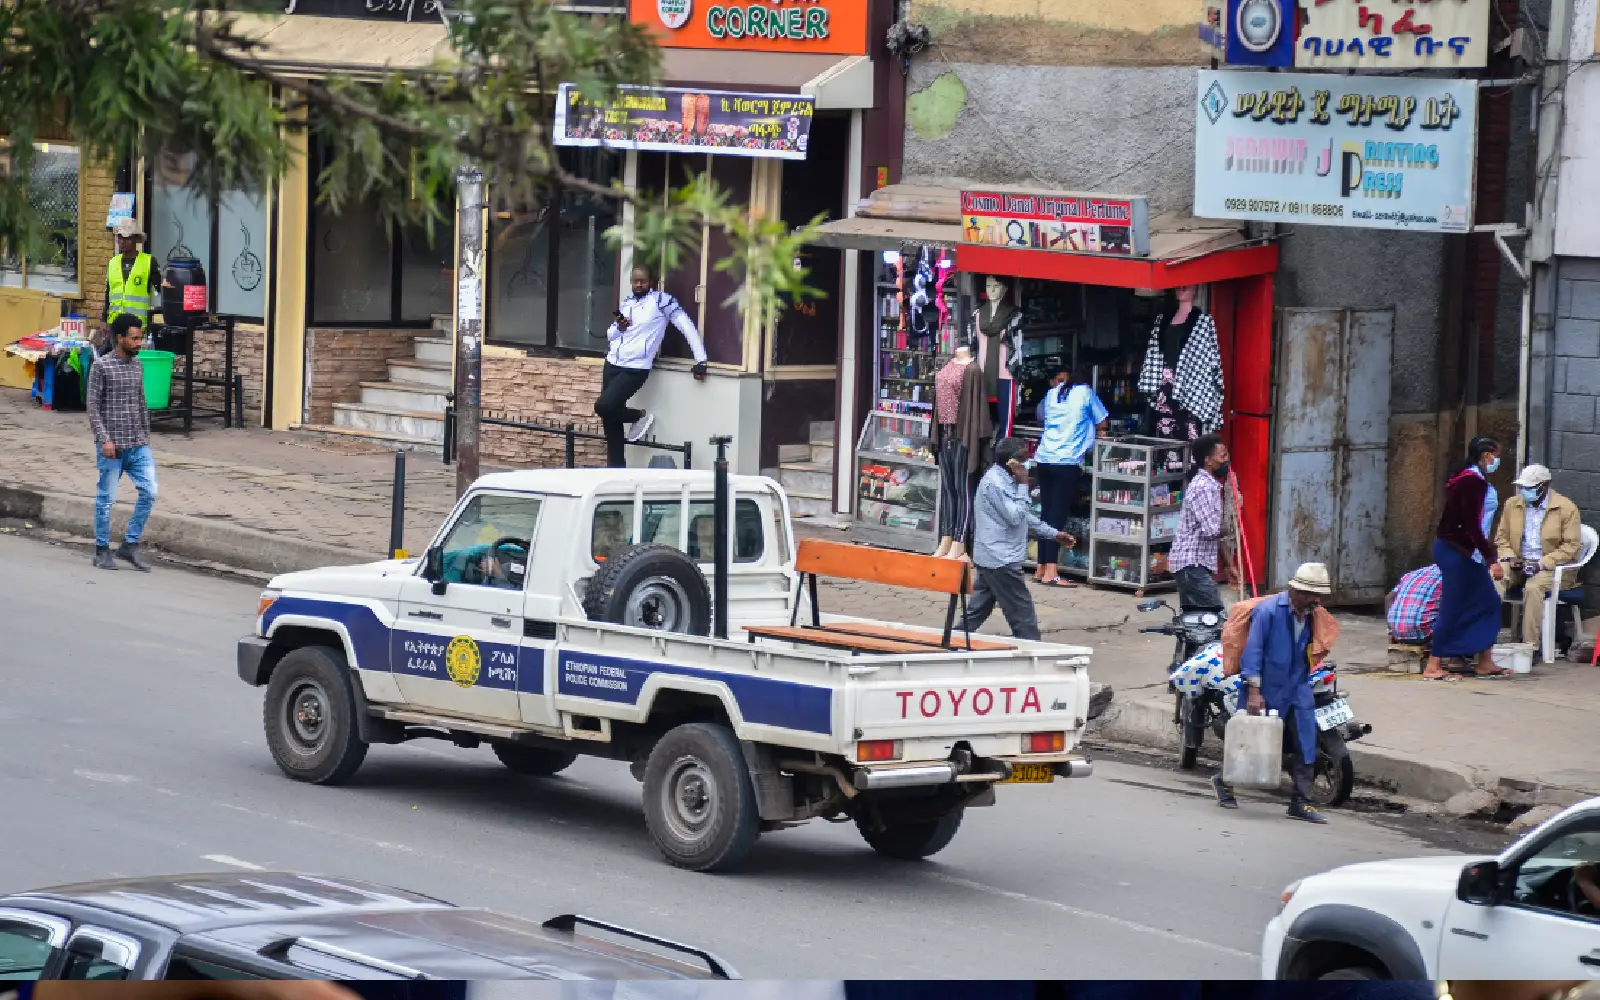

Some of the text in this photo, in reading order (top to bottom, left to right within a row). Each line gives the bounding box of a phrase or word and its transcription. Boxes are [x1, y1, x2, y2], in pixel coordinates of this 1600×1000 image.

[706, 6, 829, 39] CORNER
[1415, 36, 1471, 57] ቡና
[1420, 93, 1460, 131] ቤት
[1315, 137, 1333, 177] J
[964, 191, 999, 210] Cosmo
[1037, 196, 1081, 218] Original
[1084, 200, 1130, 220] Perfume
[1225, 198, 1247, 210] 0929
[1288, 202, 1309, 214] 0911
[565, 660, 627, 679] ETHIOPIAN FEDERAL
[565, 673, 628, 692] POLICE COMMISSION
[896, 686, 1041, 719] TOYOTA
